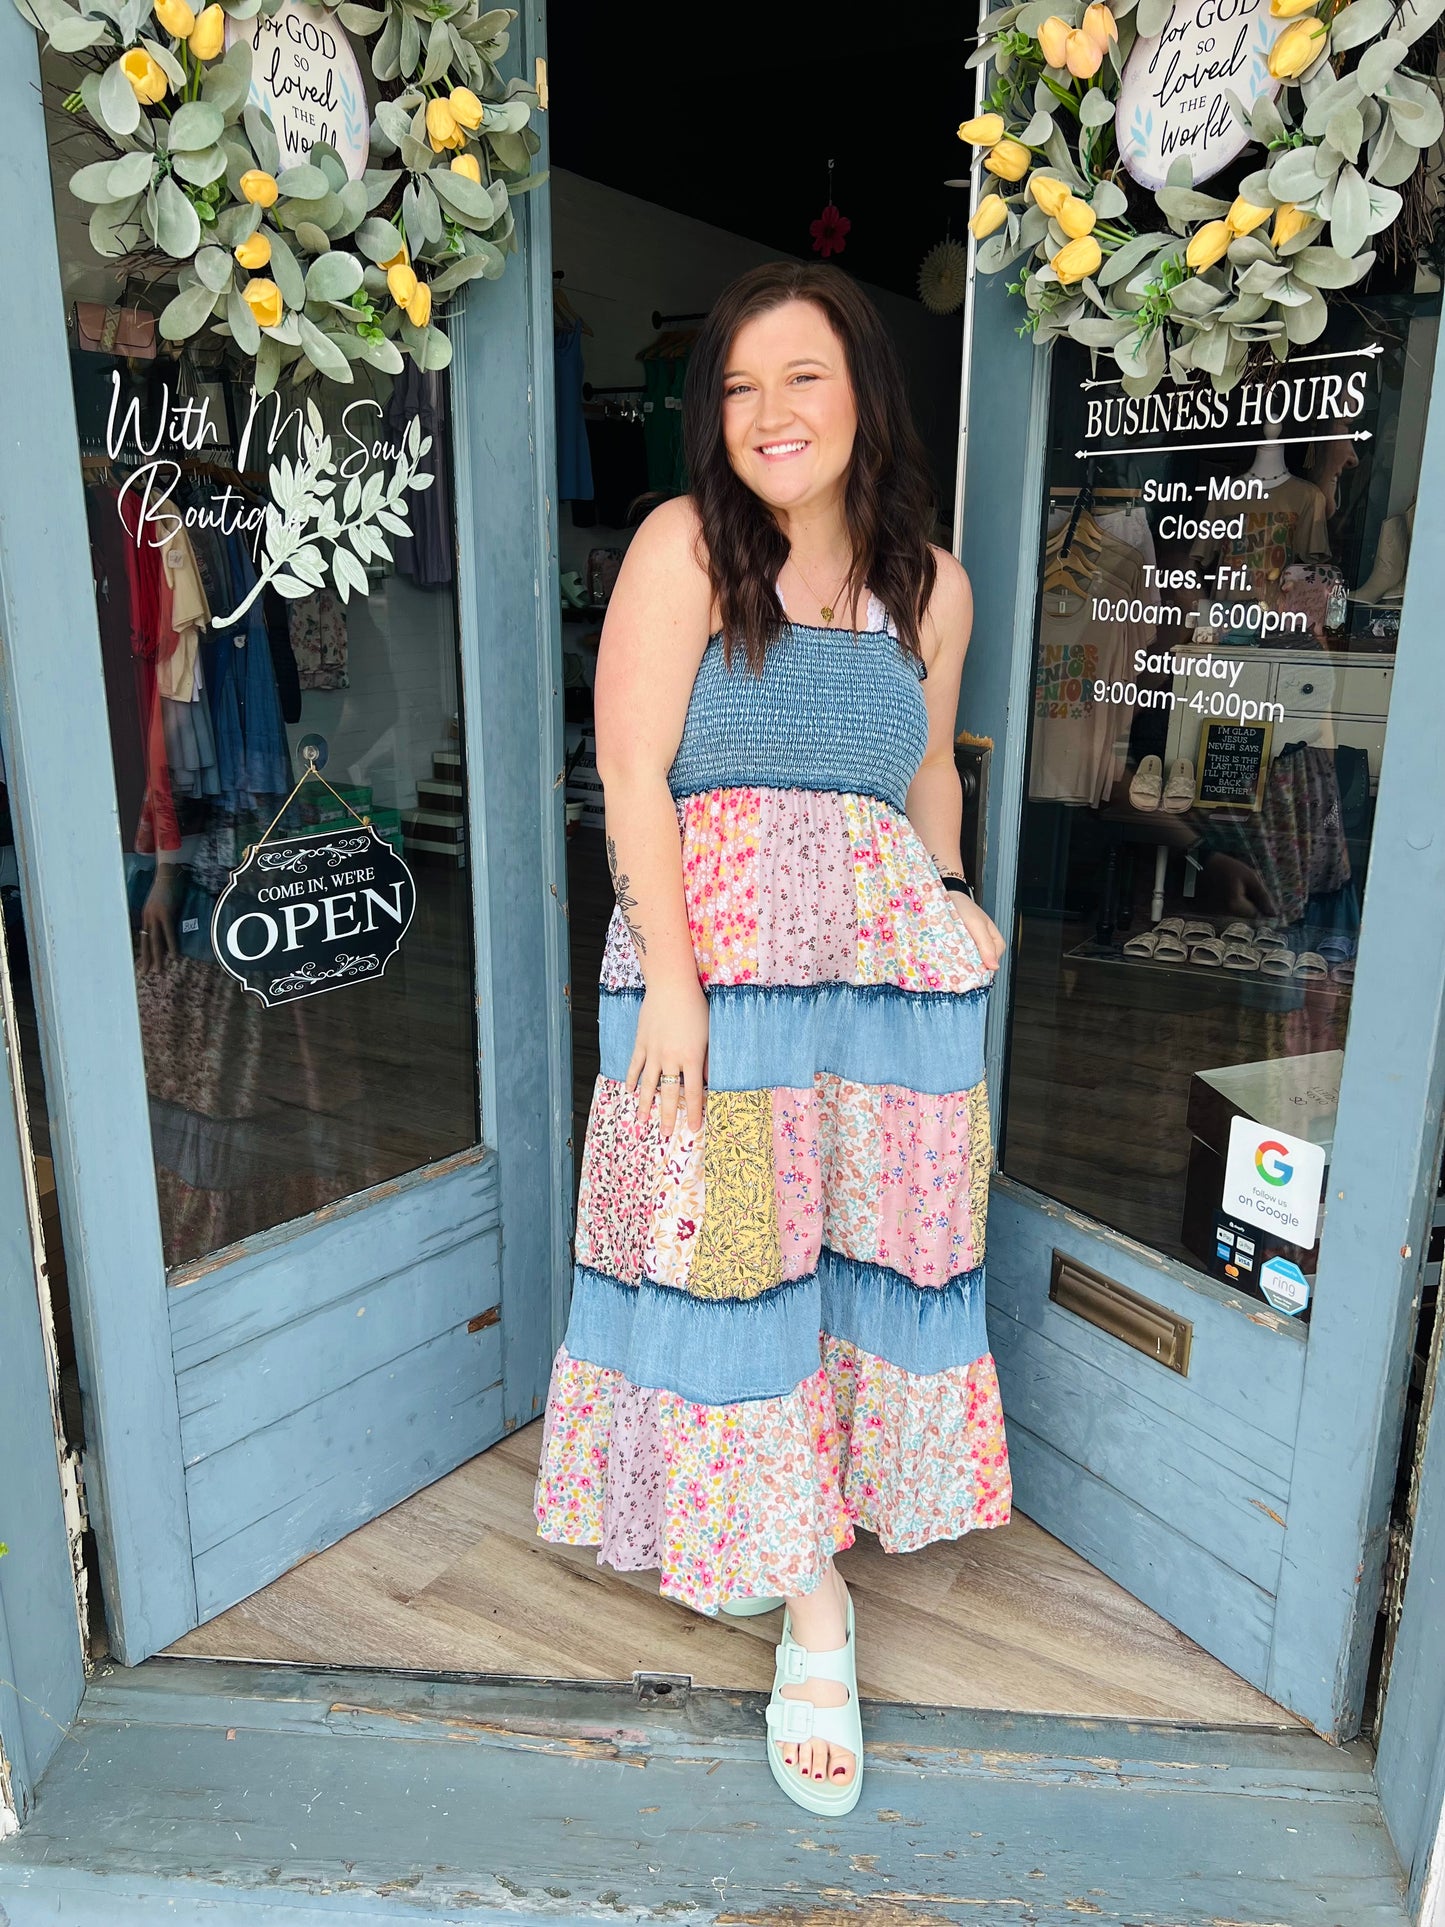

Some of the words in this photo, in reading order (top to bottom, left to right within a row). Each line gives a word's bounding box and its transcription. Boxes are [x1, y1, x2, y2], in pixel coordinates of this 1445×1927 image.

[285, 14, 336, 60] GOD
[1196, 37, 1216, 56] SO
[293, 54, 310, 72] SO
[1153, 23, 1249, 108] loved
[264, 46, 338, 112] loved
[1179, 95, 1207, 114] THE
[292, 106, 316, 126] THE
[106, 369, 218, 460] With
[1085, 388, 1230, 438] BUSINESS
[1236, 371, 1368, 427] HOURS
[1158, 512, 1245, 540] Closed
[1091, 597, 1182, 626] 10:00am
[1208, 602, 1308, 639] 6:00pm
[1133, 649, 1245, 688] Saturday
[1092, 679, 1285, 727] 9:00am-4:00pm
[1222, 735, 1248, 744] JESUS
[1232, 727, 1257, 737] GLAD
[1208, 742, 1236, 751] NEVER
[1211, 762, 1232, 771] LAST
[1235, 764, 1255, 772] TIME
[1241, 756, 1259, 765] THE
[1204, 769, 1219, 777] I'LL
[1221, 770, 1238, 778] PUT
[1240, 772, 1258, 780] YOU
[1218, 779, 1242, 787] BACK
[257, 881, 304, 903] COME
[307, 877, 329, 893] IN,
[330, 867, 376, 888] WE'RE
[226, 880, 406, 962] OPEN
[1252, 1187, 1277, 1203] follow
[1277, 1199, 1288, 1208] us
[1238, 1194, 1253, 1207] on
[1256, 1200, 1299, 1227] Google
[1238, 1257, 1251, 1267] VISA
[1272, 1275, 1296, 1297] ring
